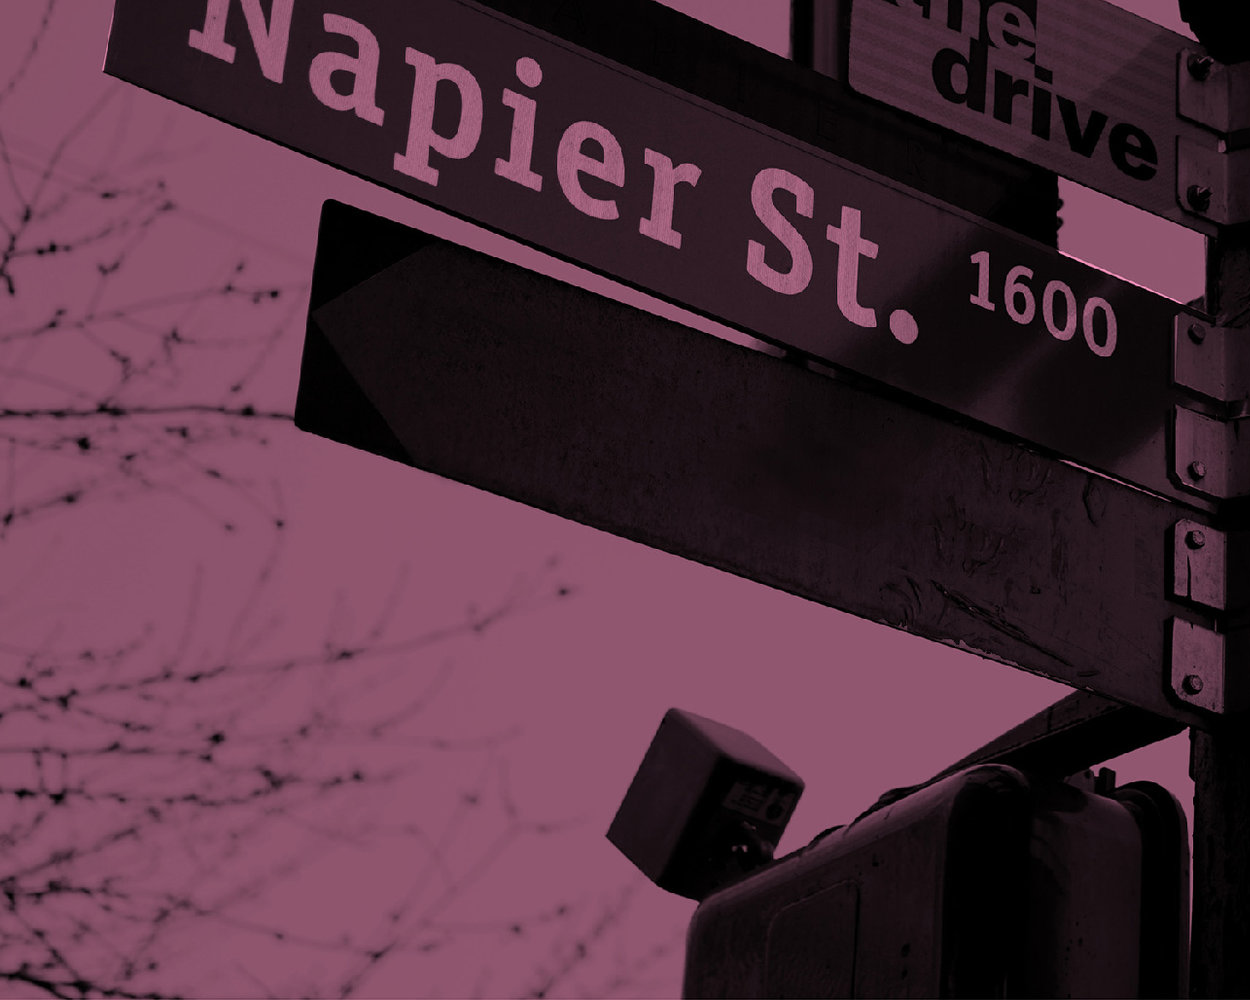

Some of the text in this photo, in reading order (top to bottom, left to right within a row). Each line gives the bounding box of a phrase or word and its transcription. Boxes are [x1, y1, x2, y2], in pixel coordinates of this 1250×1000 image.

[931, 36, 1159, 181] drive
[746, 166, 920, 345] St.
[969, 250, 1118, 358] 1600
